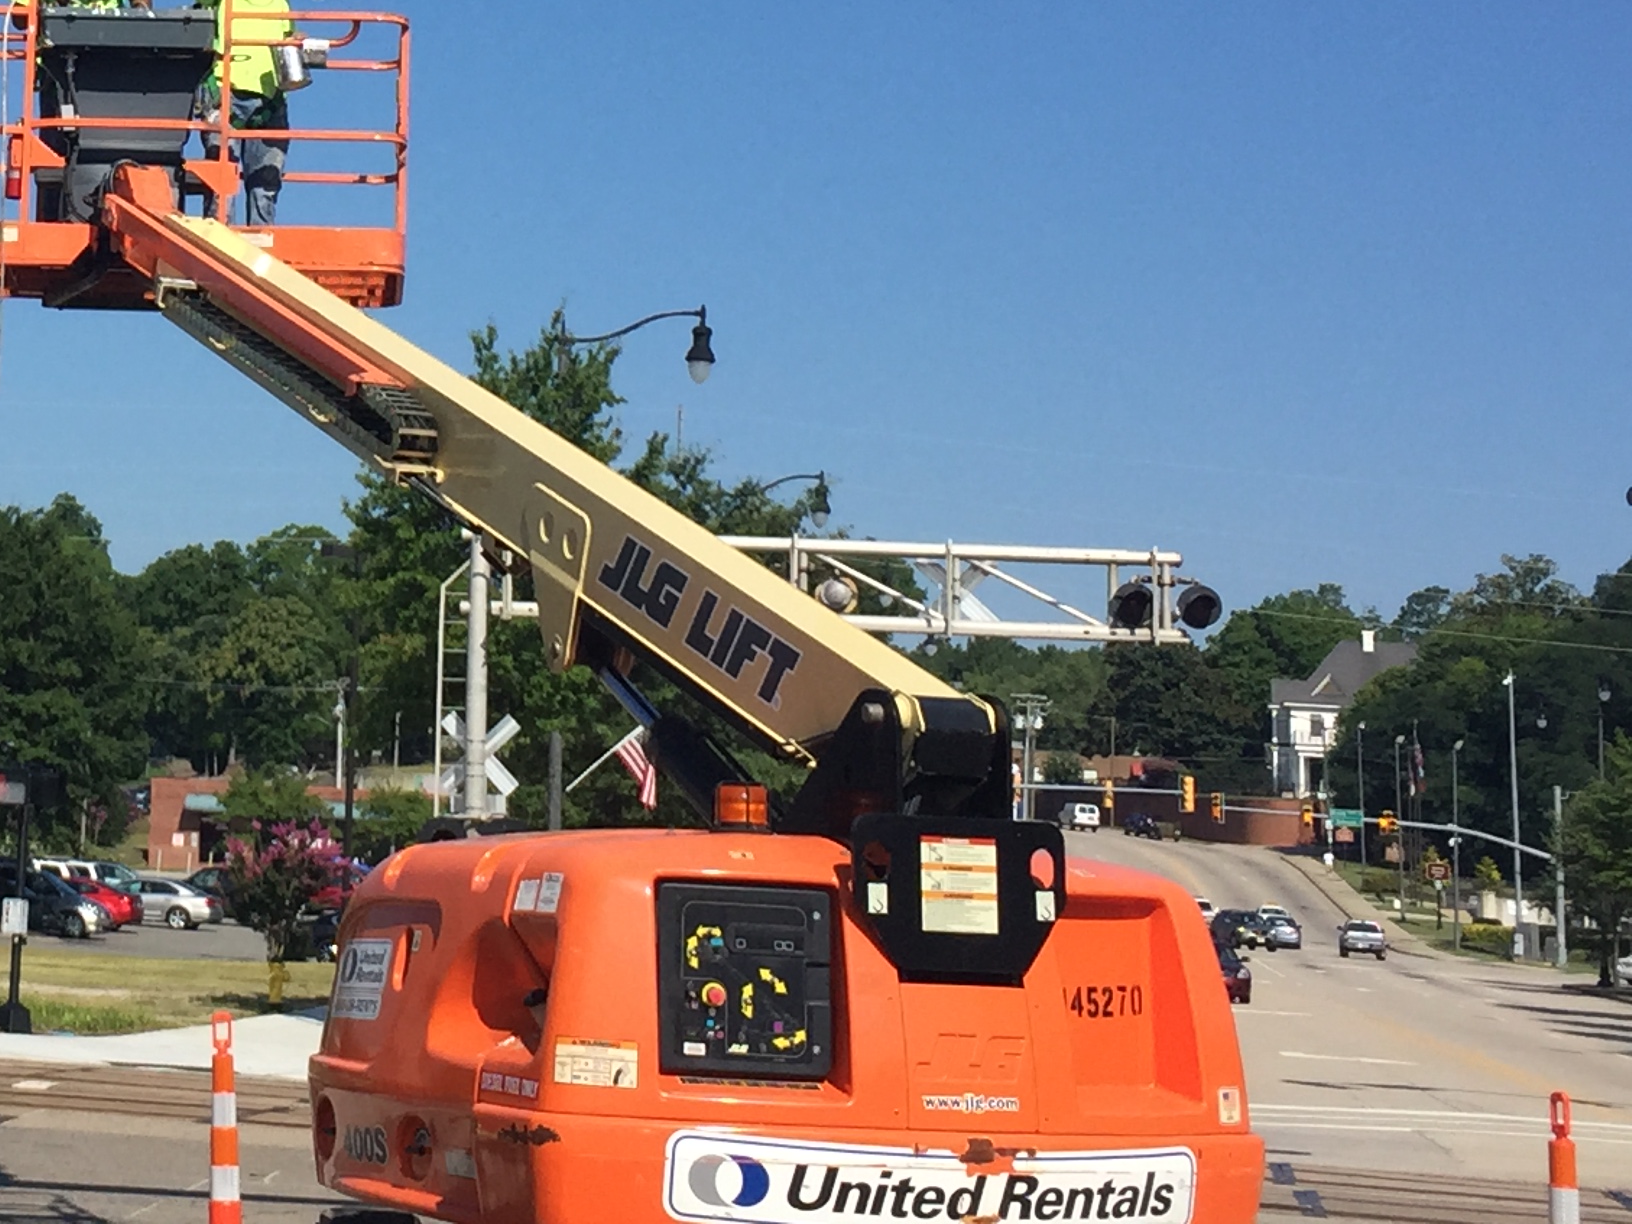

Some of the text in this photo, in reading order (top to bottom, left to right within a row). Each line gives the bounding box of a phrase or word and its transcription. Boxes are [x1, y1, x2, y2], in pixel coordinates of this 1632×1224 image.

[597, 534, 803, 705] JLG LIFT
[924, 1094, 1019, 1113] www.jlg.com
[786, 1163, 1175, 1222] United Rentals
